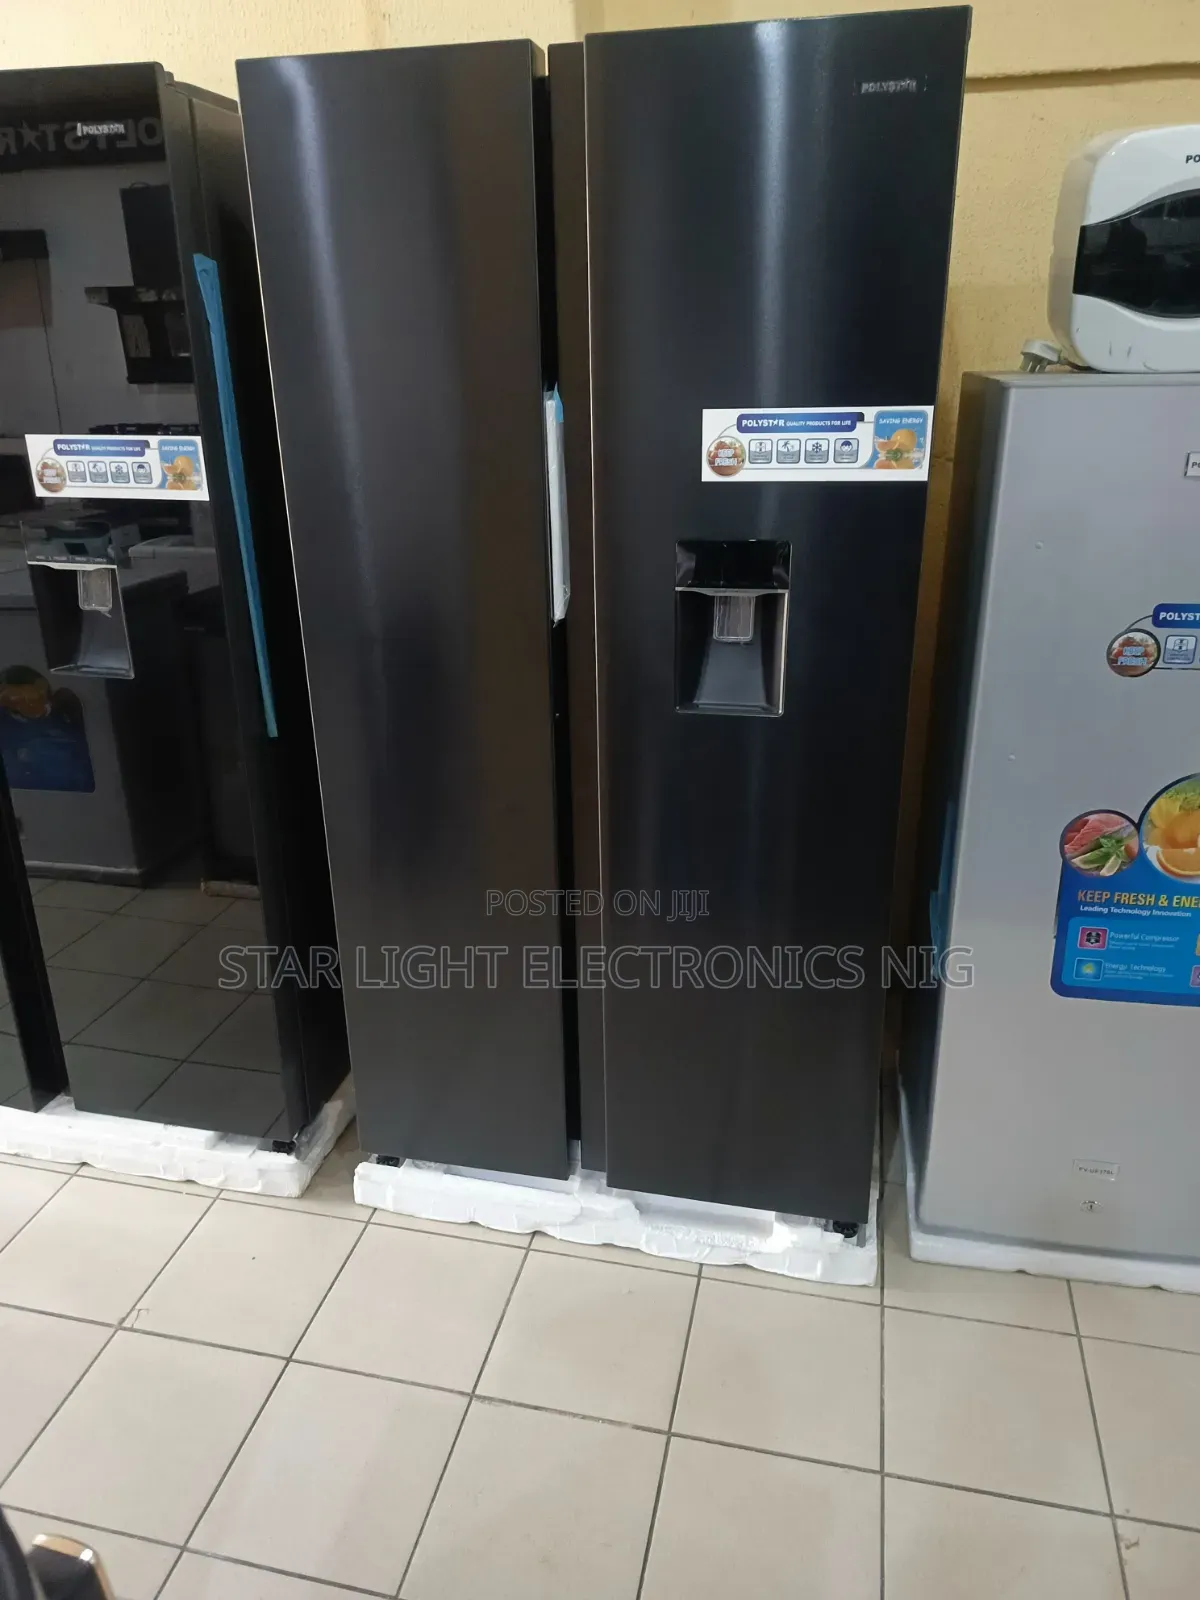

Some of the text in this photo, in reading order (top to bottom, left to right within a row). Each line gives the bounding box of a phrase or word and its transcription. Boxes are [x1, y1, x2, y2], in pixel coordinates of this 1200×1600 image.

[1078, 890, 1111, 903] KEEP
[1113, 892, 1156, 906] FRESH
[1158, 894, 1168, 907] &
[1080, 905, 1192, 917] Leading Technology Innovation
